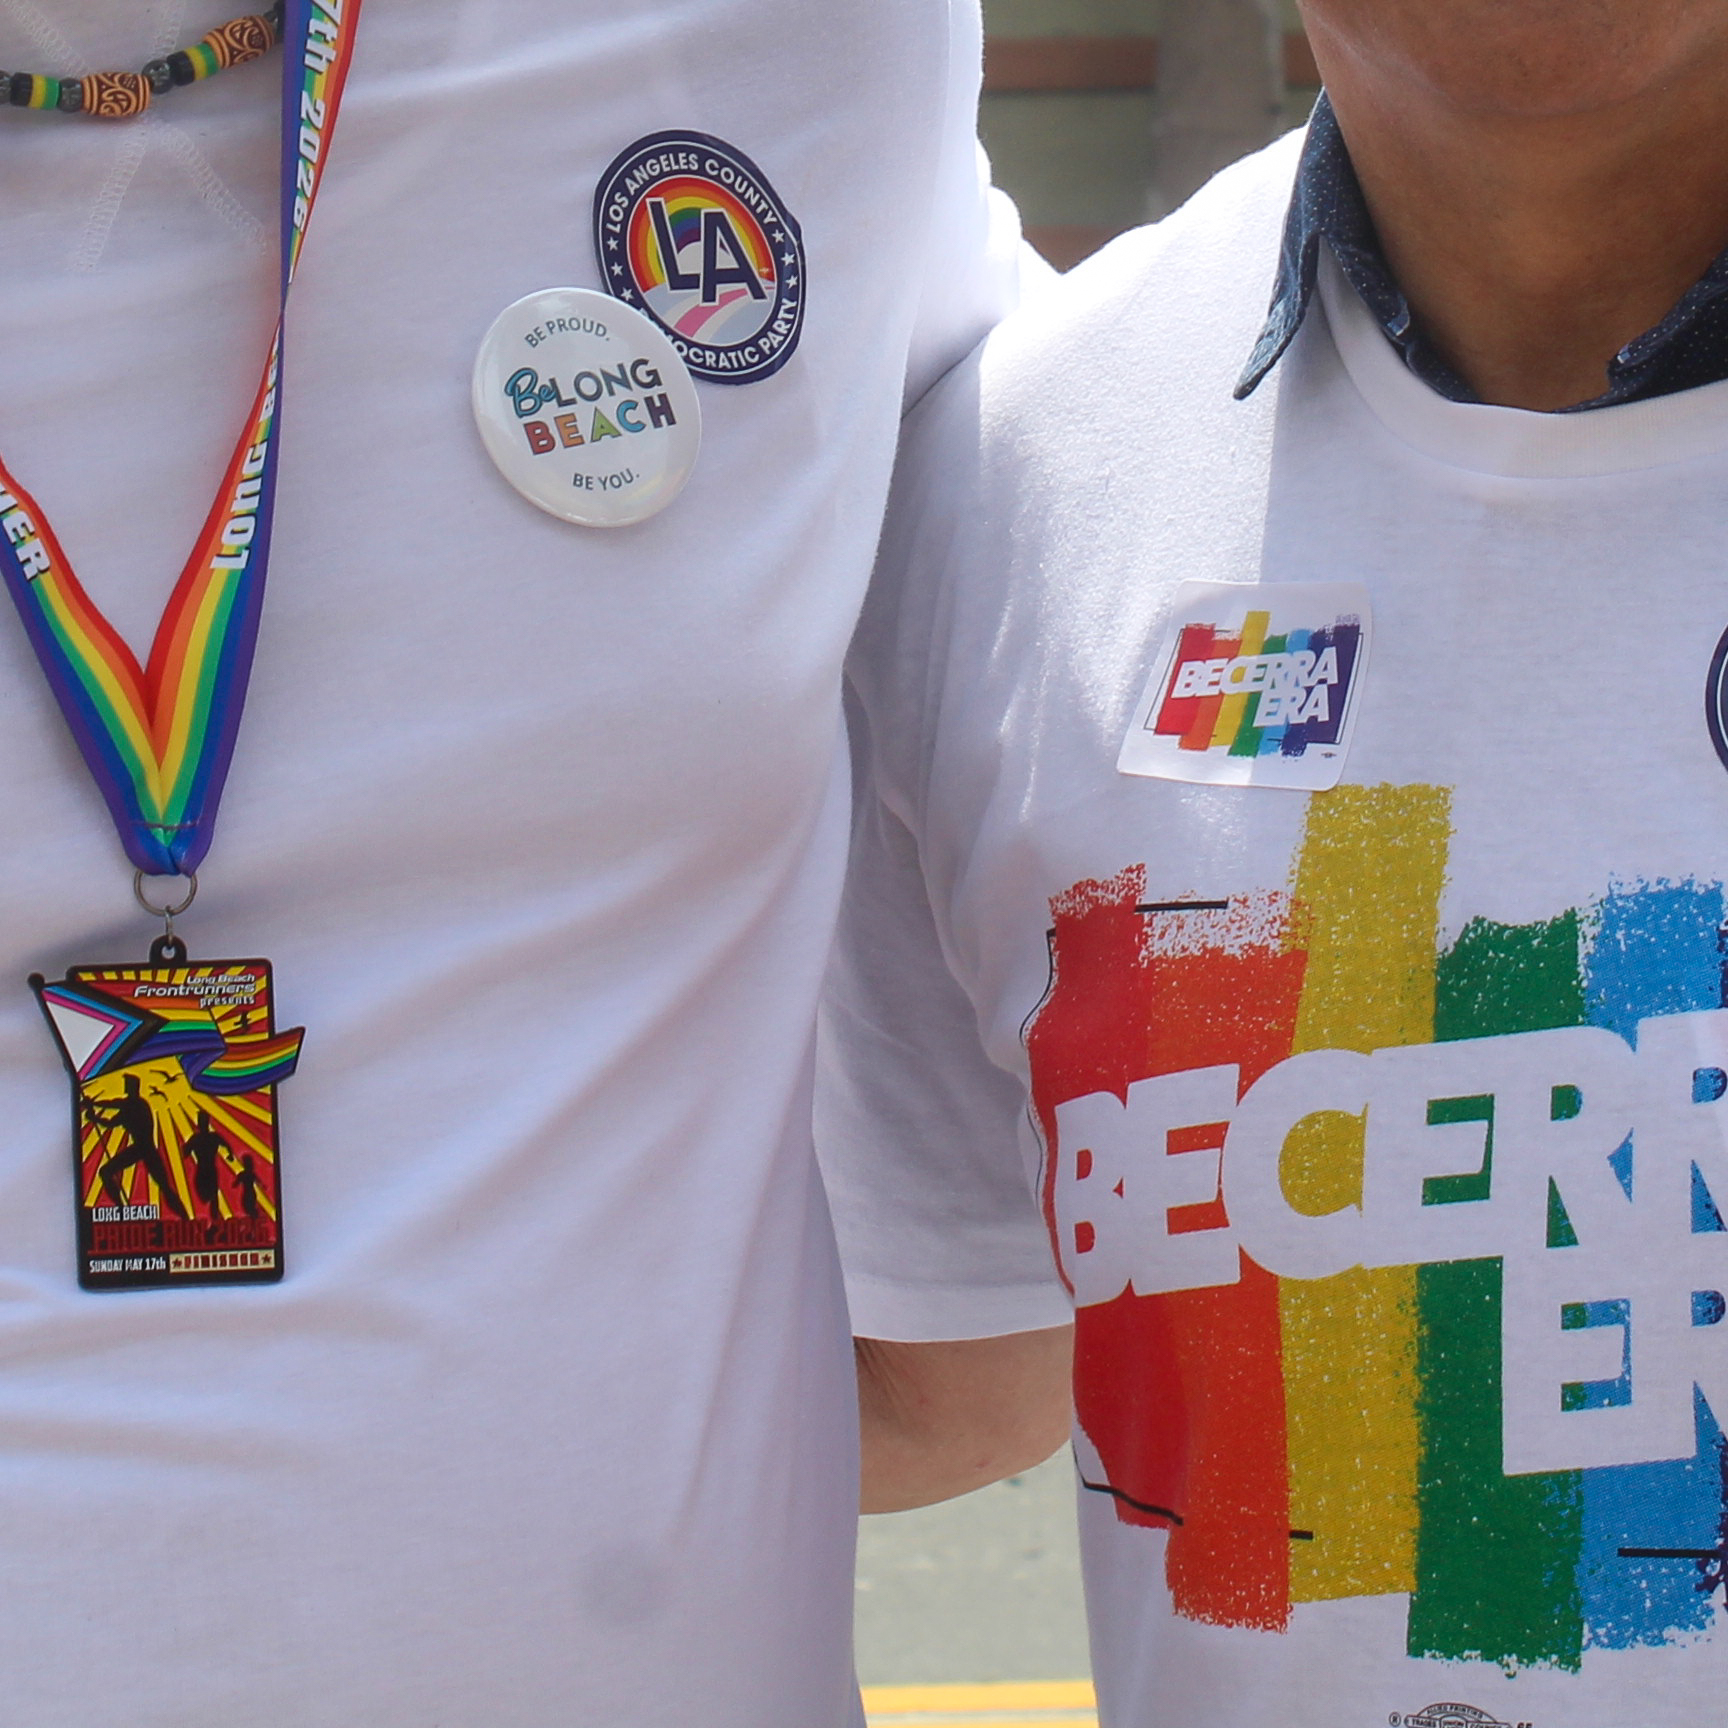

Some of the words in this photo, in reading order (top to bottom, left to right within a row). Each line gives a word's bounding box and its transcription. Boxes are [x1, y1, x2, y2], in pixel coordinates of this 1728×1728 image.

[605, 194, 630, 234] LOS
[625, 151, 700, 198] ANGELES
[703, 157, 778, 228] COUNTY
[645, 195, 770, 307] LA
[524, 323, 548, 349] BE
[545, 316, 612, 344] PROUD.
[758, 298, 799, 356] PARTY
[523, 390, 677, 456] BEACH
[572, 471, 595, 492] BE
[597, 468, 640, 493] YOU.
[1170, 646, 1340, 700] BECERRA
[1252, 682, 1330, 728] ERA
[133, 983, 256, 998] Frontrunners
[186, 975, 216, 985] Long
[217, 973, 256, 984] Beach
[199, 995, 256, 1009] presents
[123, 1205, 159, 1221] BEACH
[90, 1258, 123, 1273] SUNDAY
[125, 1257, 144, 1272] MAY
[145, 1257, 167, 1271] 17th
[184, 1253, 260, 1270] FINISHER
